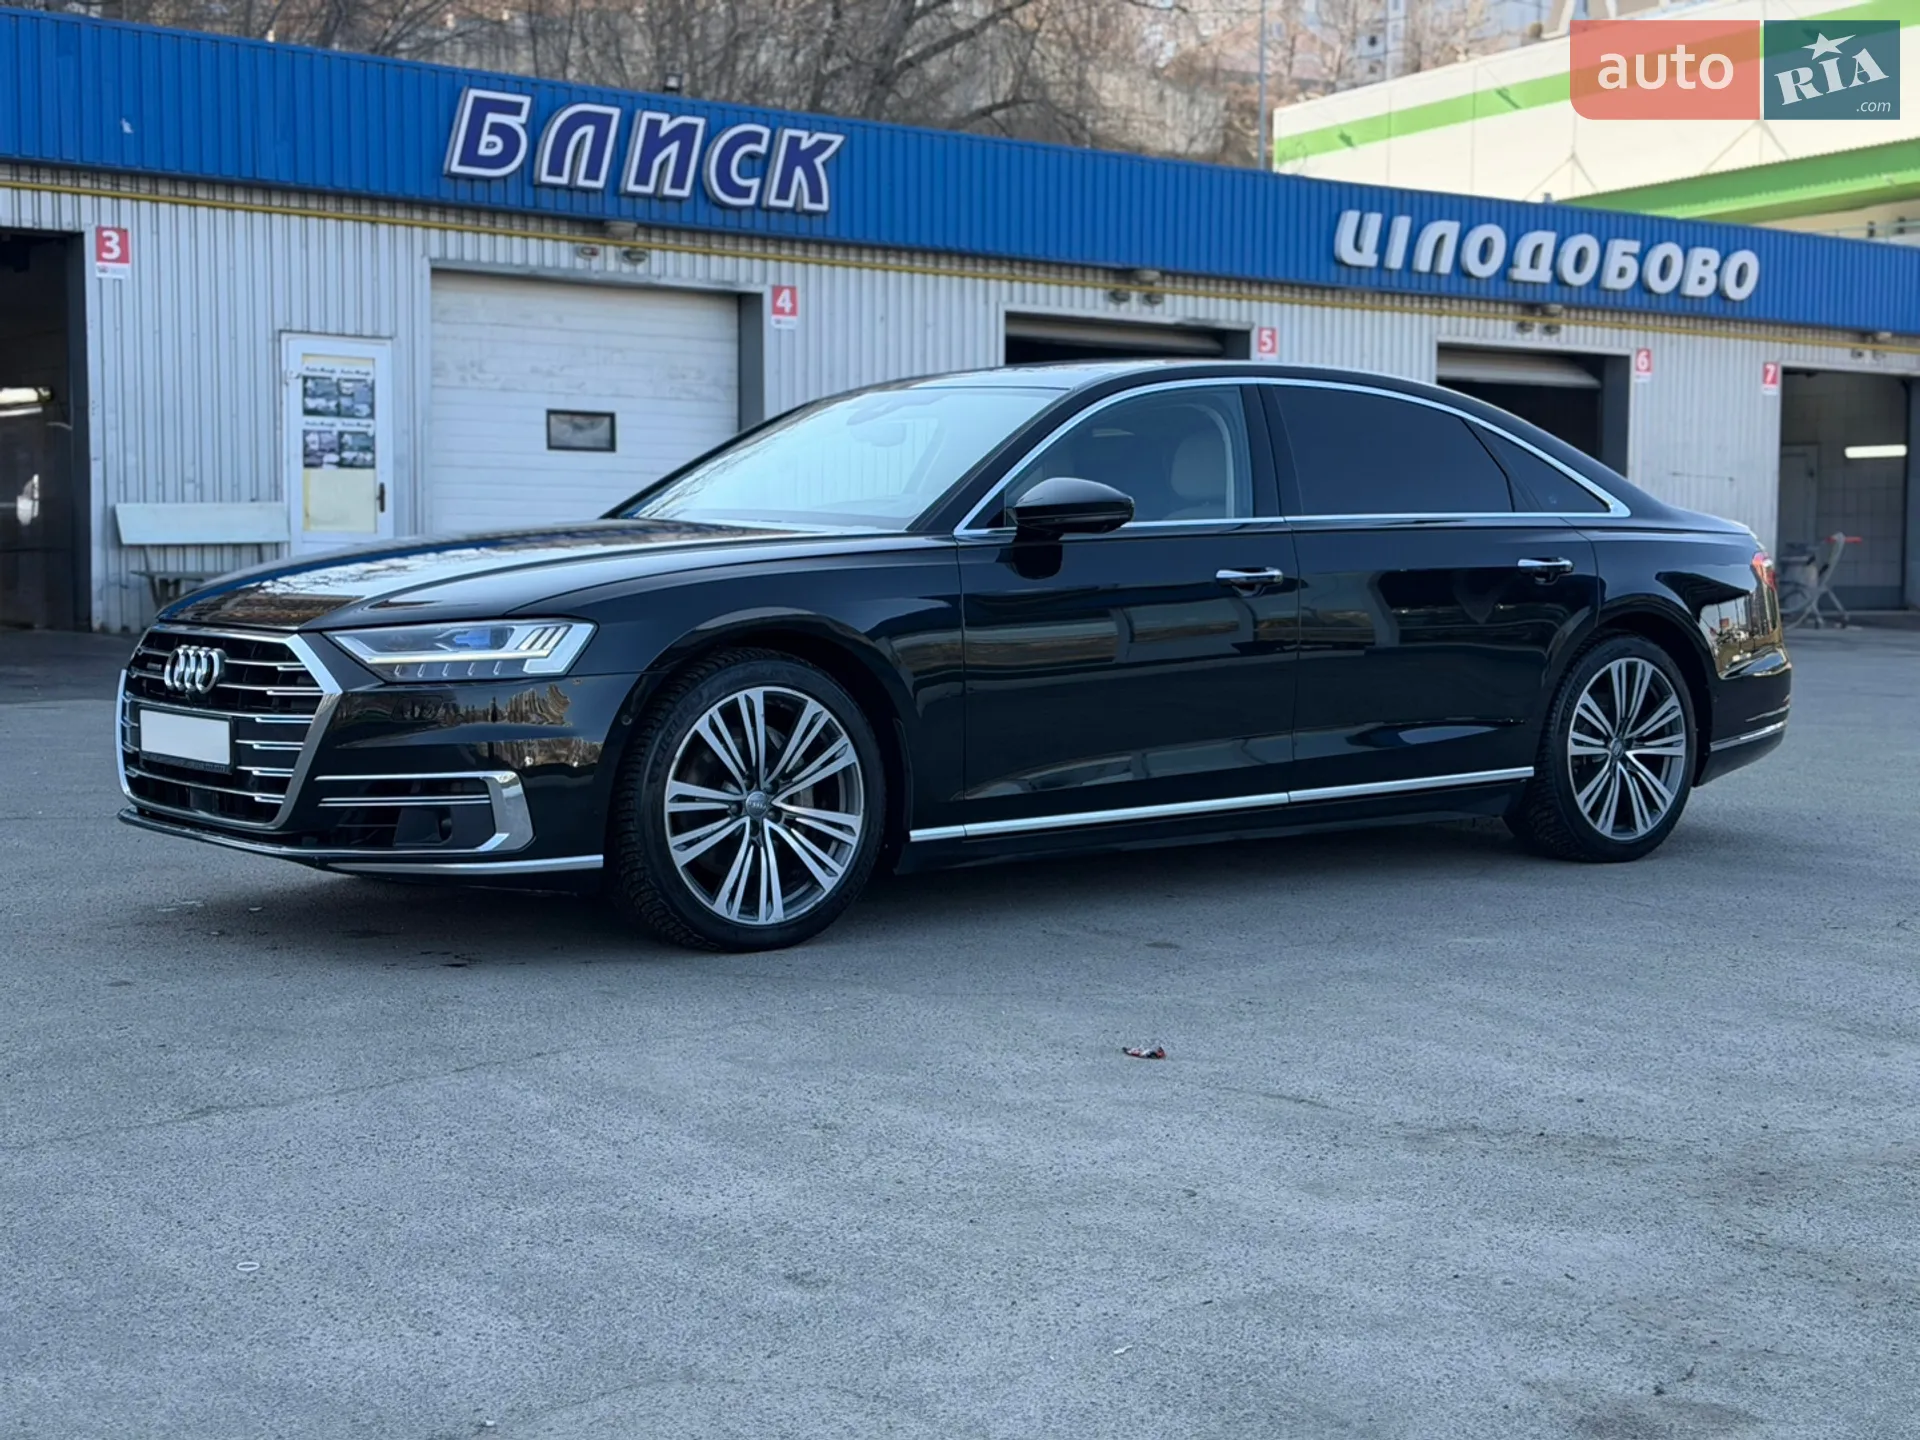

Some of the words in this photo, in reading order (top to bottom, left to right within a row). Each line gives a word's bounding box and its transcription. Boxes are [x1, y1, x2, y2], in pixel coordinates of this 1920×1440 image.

[445, 86, 845, 213] БЛИСК
[101, 230, 121, 260] 3
[1333, 209, 1760, 301] ЦІЛОДОБОВО
[776, 288, 793, 313] 4
[1260, 329, 1273, 352] 5
[1636, 350, 1650, 371] 6
[1765, 363, 1777, 384] 7
